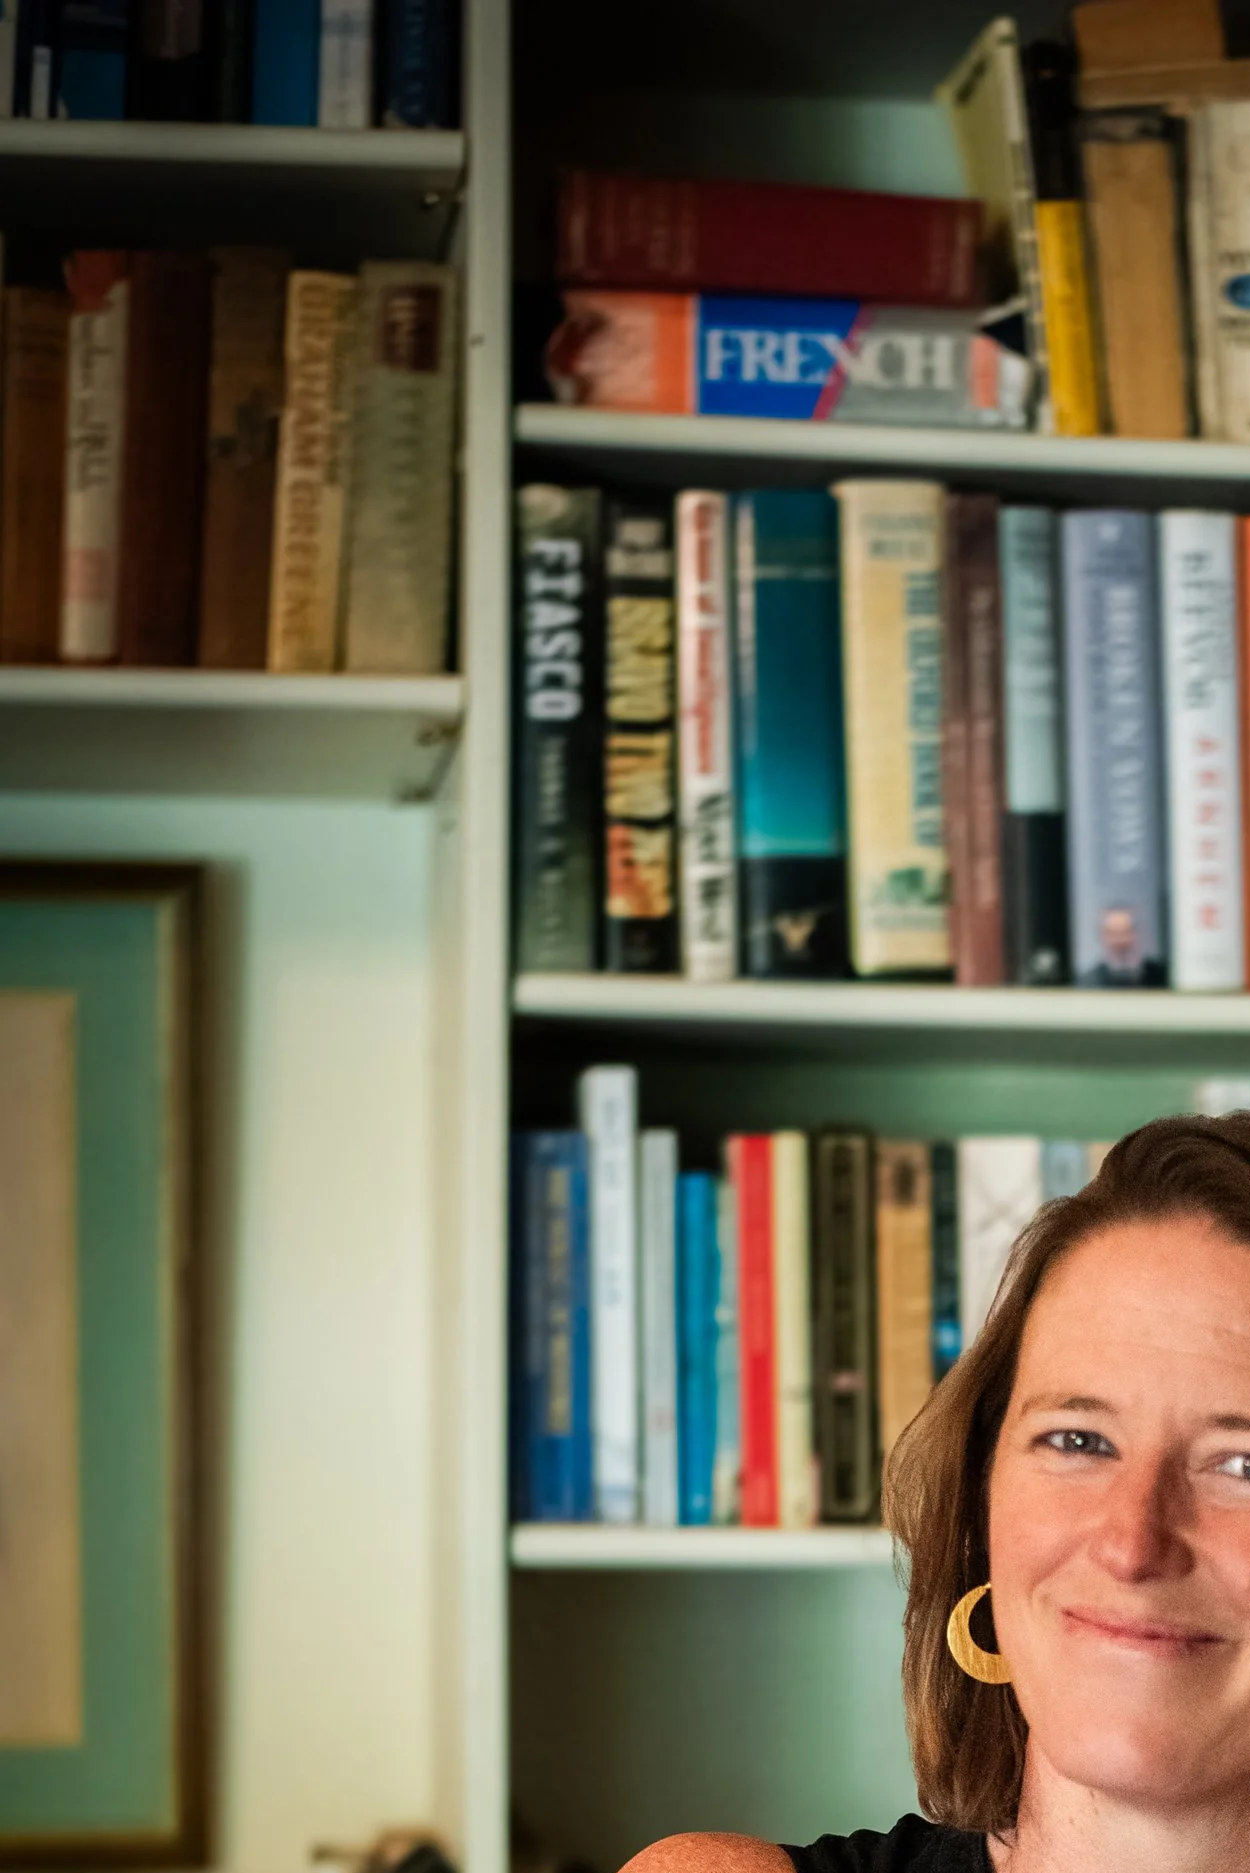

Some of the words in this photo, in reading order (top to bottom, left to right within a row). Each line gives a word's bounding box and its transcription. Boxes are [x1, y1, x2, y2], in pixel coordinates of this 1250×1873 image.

[704, 328, 957, 390] FRENCH
[526, 538, 582, 721] FIASCO
[606, 597, 673, 722] BRAVO
[605, 732, 673, 818] TWO
[605, 824, 671, 918] ZERO
